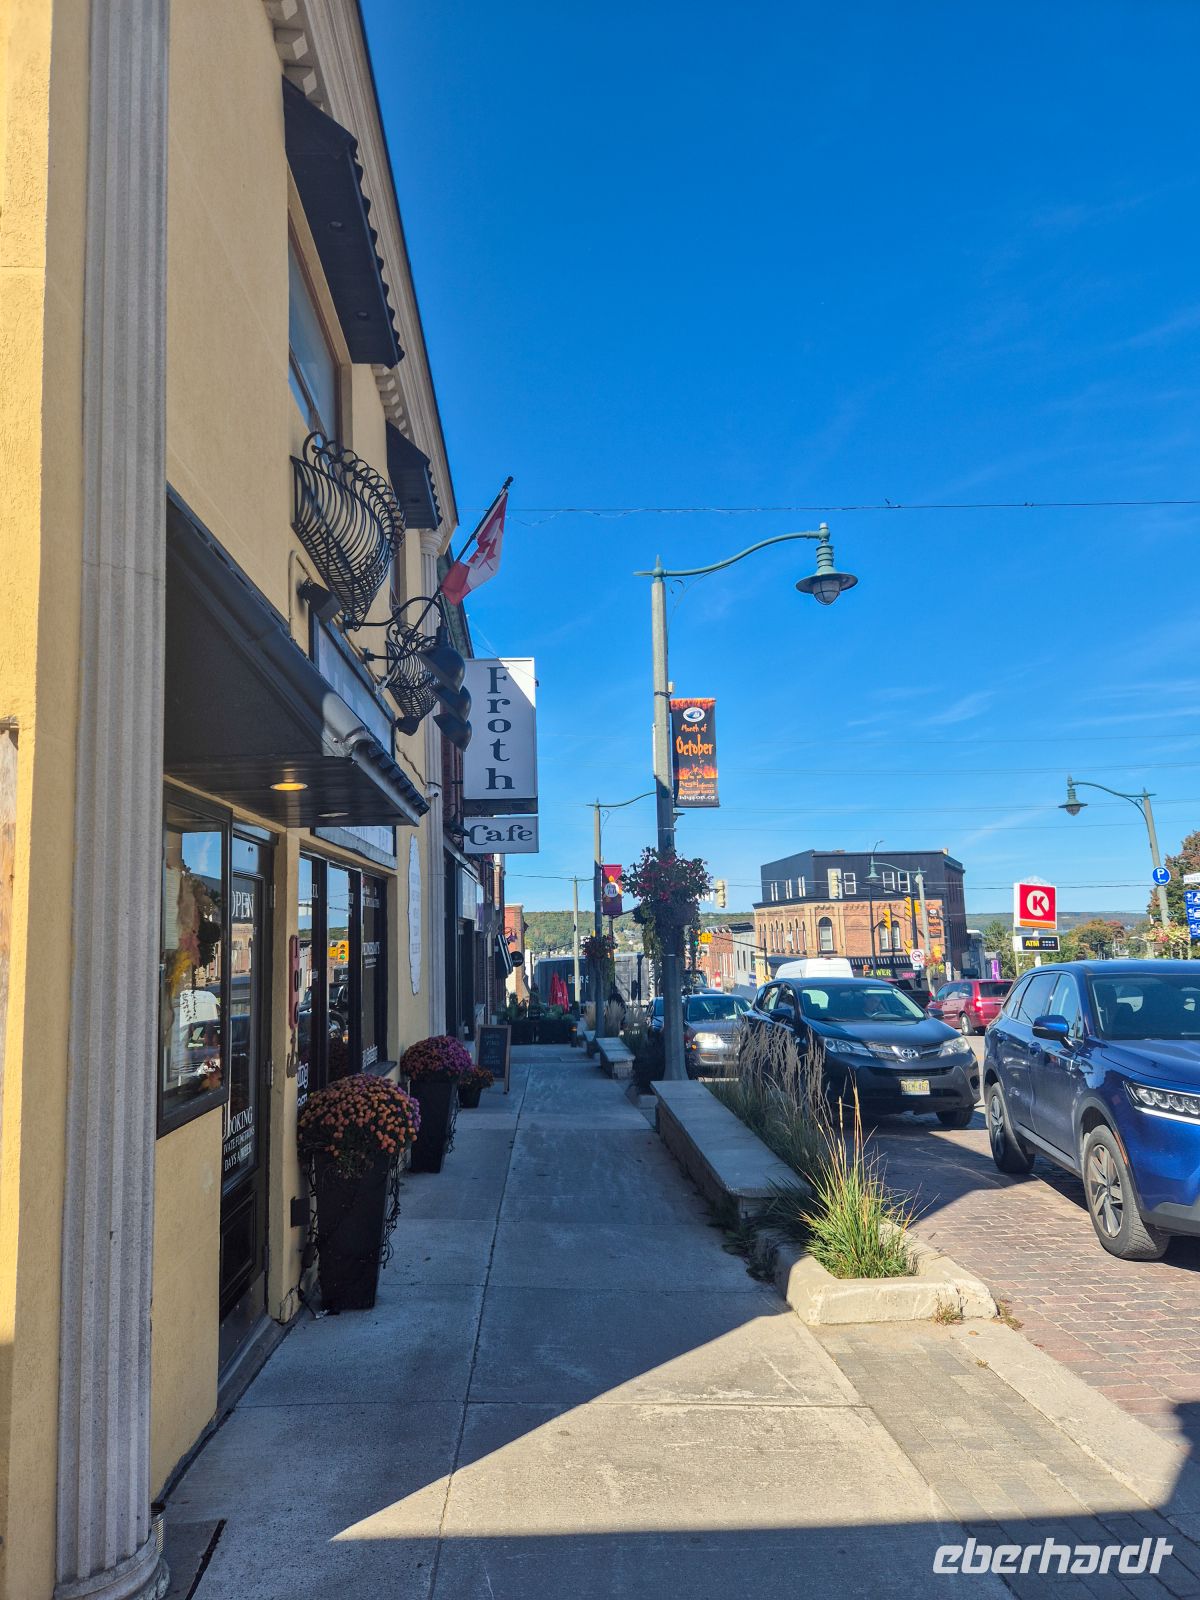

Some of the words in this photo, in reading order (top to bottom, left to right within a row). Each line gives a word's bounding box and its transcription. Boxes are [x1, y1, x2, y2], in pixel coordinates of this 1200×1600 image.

[485, 666, 515, 790] Froth
[681, 723, 699, 733] Month
[700, 723, 707, 733] of
[676, 734, 714, 757] October
[469, 824, 533, 846] Cafe
[1025, 939, 1040, 947] ATM
